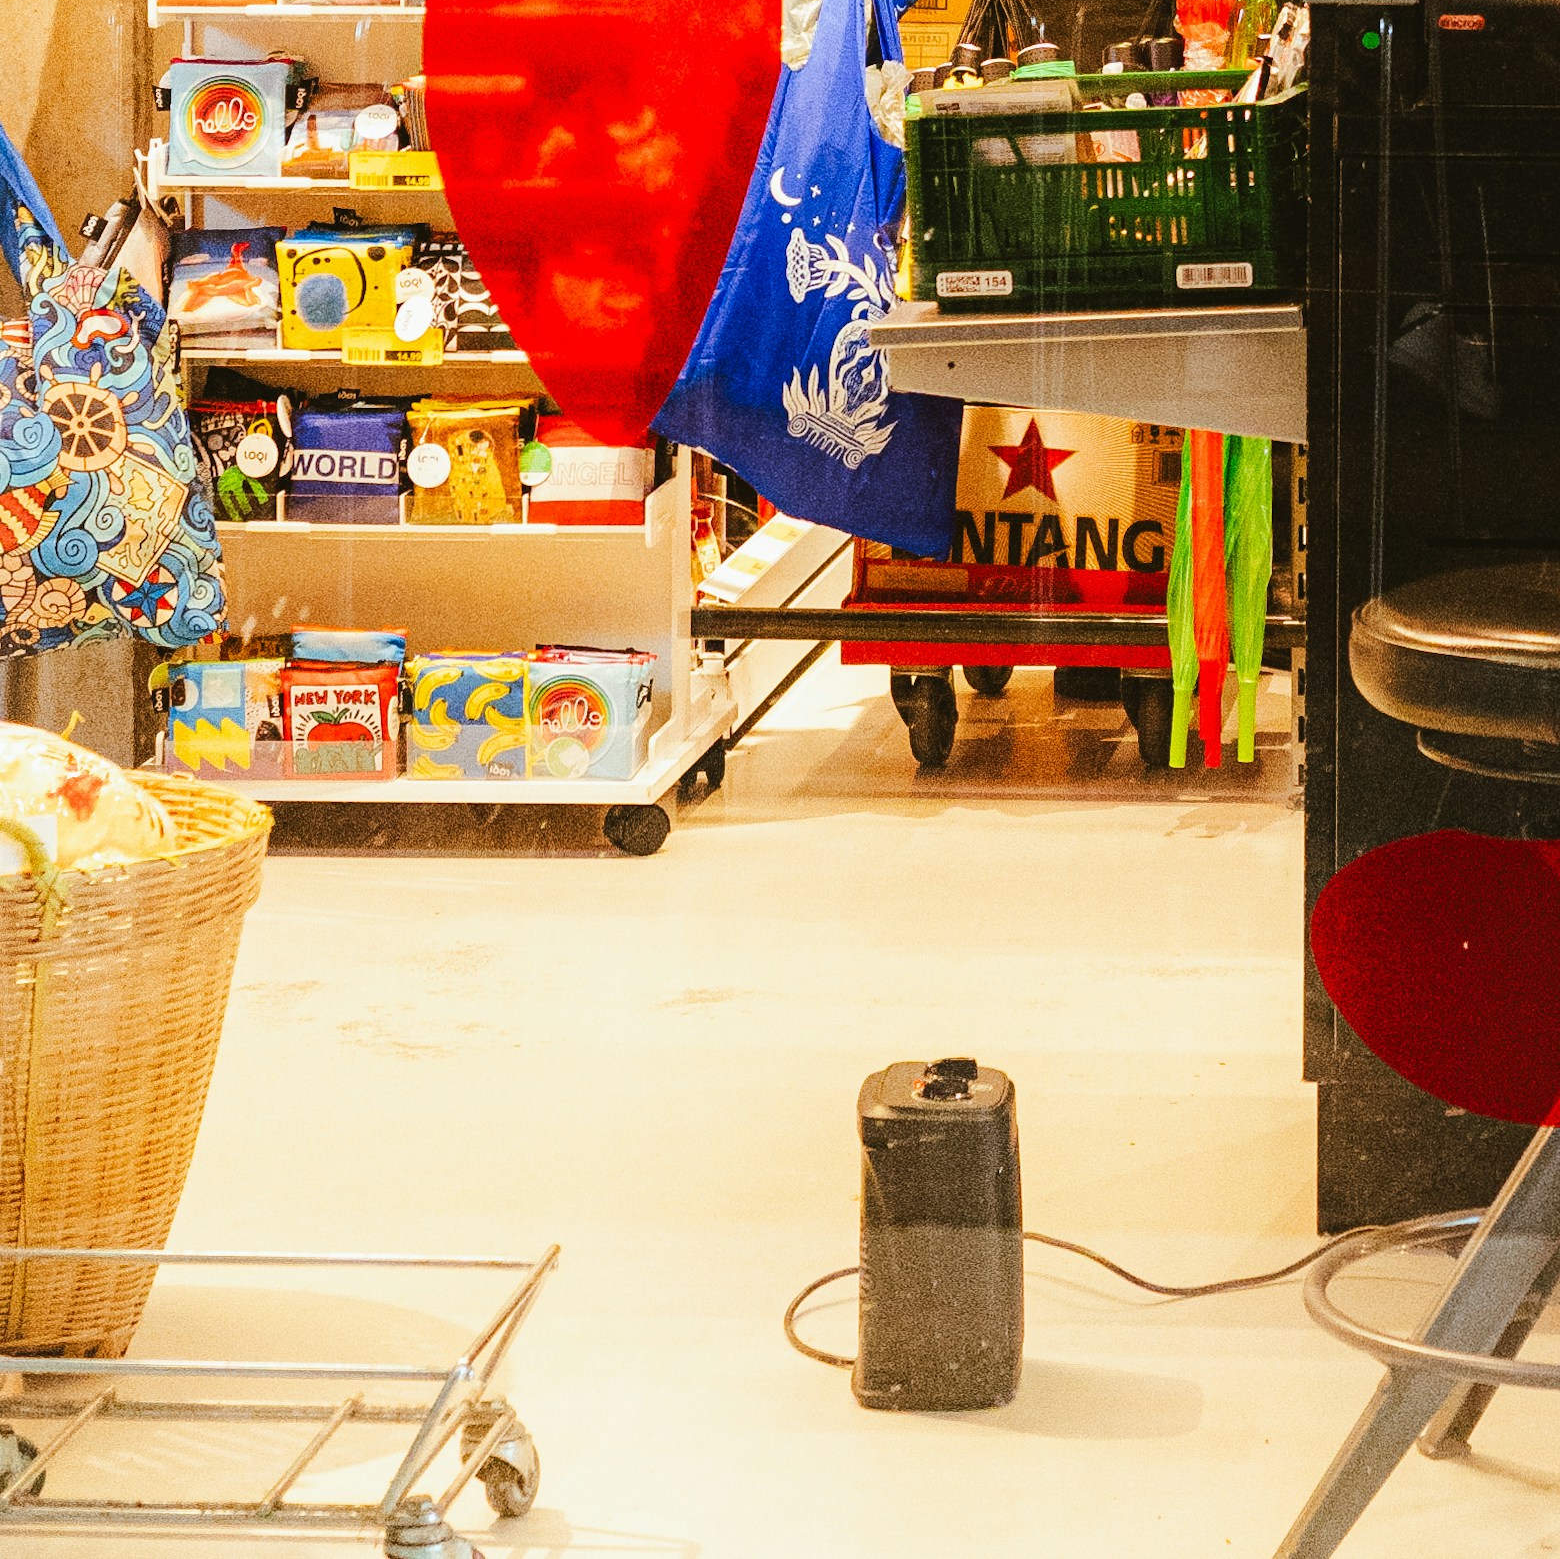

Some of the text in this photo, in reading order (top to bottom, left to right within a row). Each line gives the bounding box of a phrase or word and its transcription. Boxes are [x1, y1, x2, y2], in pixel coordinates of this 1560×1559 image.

[191, 97, 258, 138] hello
[984, 277, 1007, 289] 154
[243, 449, 267, 462] LOQI
[292, 449, 398, 481] WORLD
[294, 689, 377, 707] NEW YORK
[538, 696, 606, 736] hello
